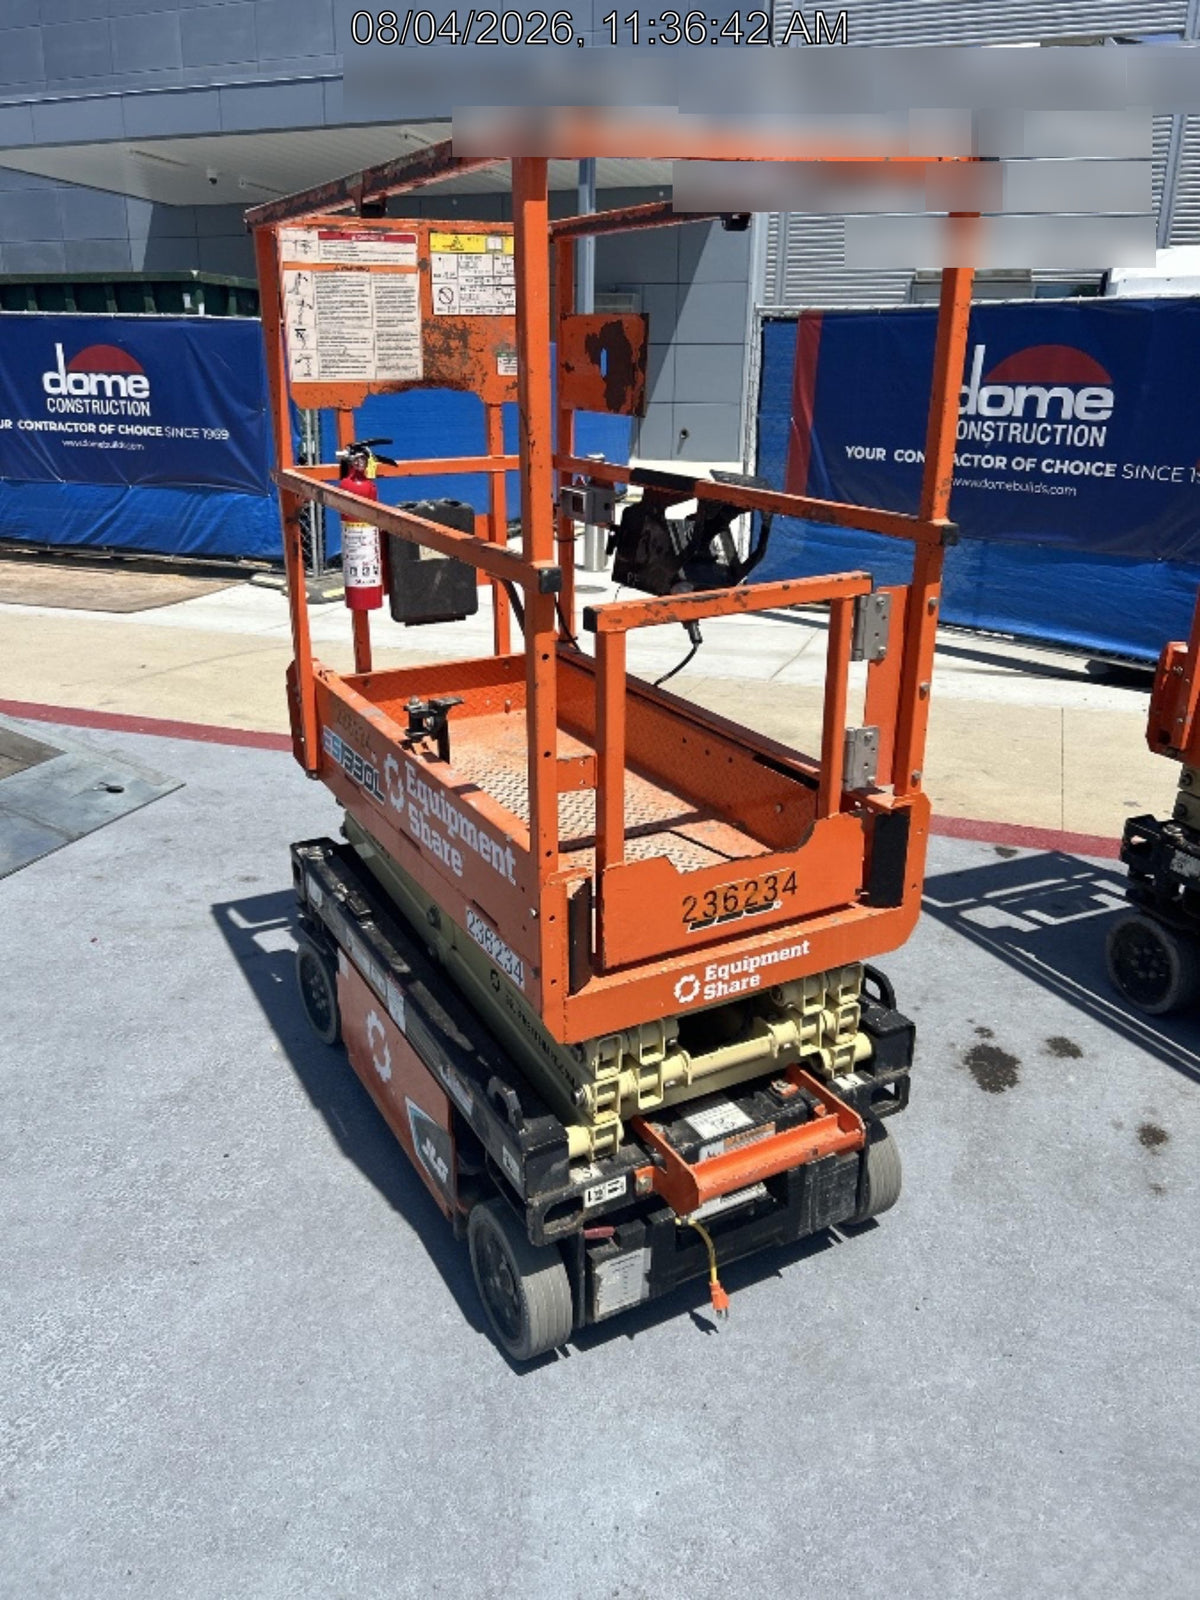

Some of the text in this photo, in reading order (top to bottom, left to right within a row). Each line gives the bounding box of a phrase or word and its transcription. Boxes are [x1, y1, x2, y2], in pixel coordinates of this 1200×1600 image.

[42, 343, 150, 399] dome
[959, 345, 1115, 421] dome
[47, 397, 151, 417] CONSTRUCTION
[17, 420, 96, 433] CONTRACTOR
[99, 424, 116, 434] OF
[118, 425, 163, 438] CHOICE
[164, 426, 199, 439] SINCE
[956, 420, 1107, 447] ONSTRUCTION
[845, 446, 886, 461] YOUR
[894, 449, 1007, 470] CONACTOR
[1011, 456, 1037, 472] OF
[1041, 459, 1117, 478] CHOICE
[1121, 463, 1185, 483] SINCE
[404, 760, 517, 879] Equipment
[408, 803, 463, 878] Share
[682, 870, 798, 923] 236234
[704, 940, 811, 981] Equipment
[703, 974, 761, 1001] Share
